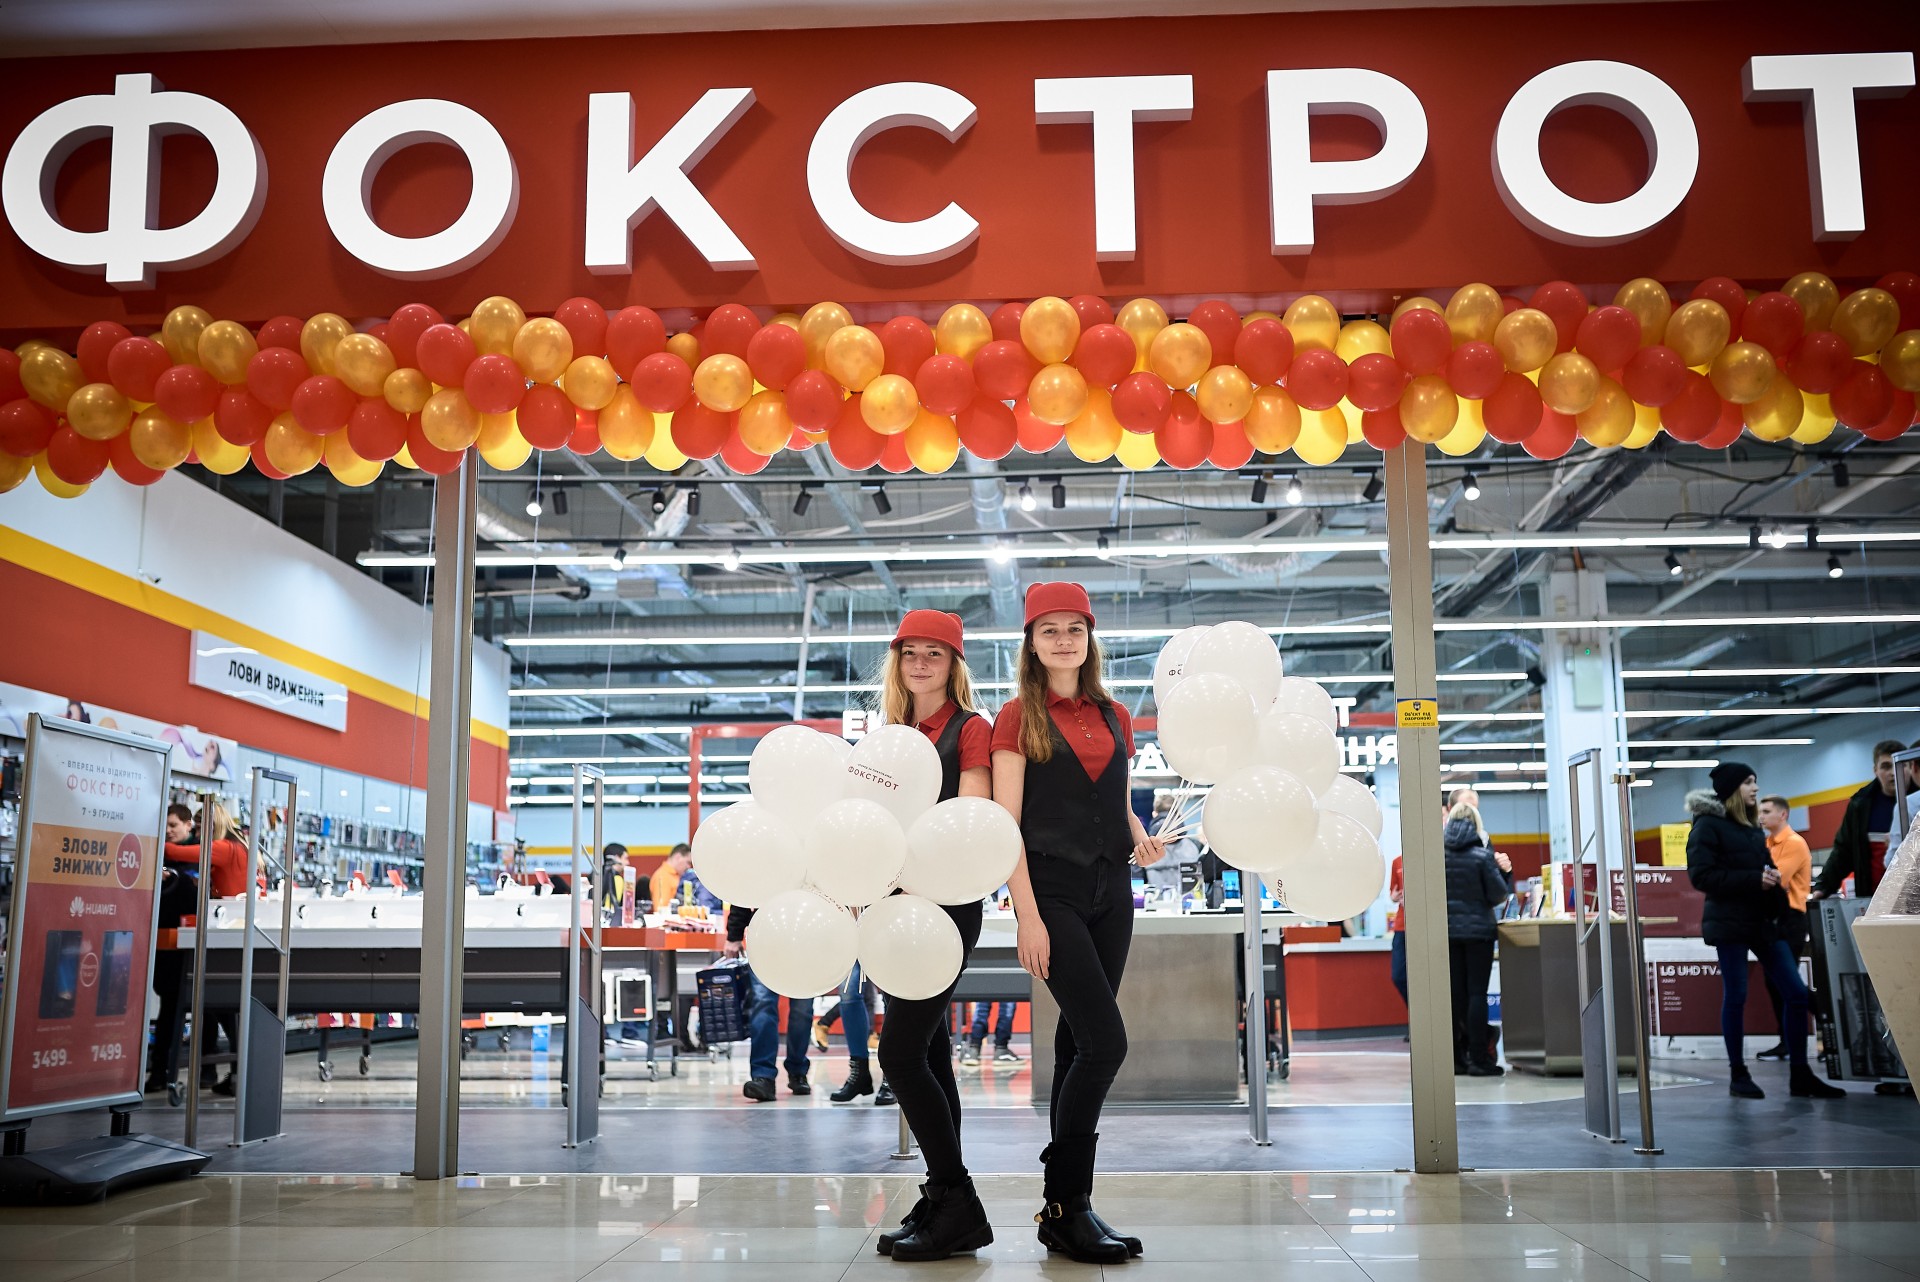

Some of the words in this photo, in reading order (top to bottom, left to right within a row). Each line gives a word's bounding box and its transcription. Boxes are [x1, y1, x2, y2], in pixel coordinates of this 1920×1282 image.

[2, 51, 1916, 287] ФОКСТРОТ
[228, 660, 261, 686] ЛОВИ
[267, 674, 324, 707] ВРАЖЕННЯ
[67, 760, 94, 773] ВПЕРЕД
[96, 766, 106, 774] НА
[107, 770, 142, 780] ВІДКРИТТЯ
[847, 766, 900, 791] ФОКСТРОТ
[66, 773, 141, 801] ФОКСТРОТ
[81, 807, 87, 816] 7
[92, 809, 97, 817] 9
[98, 809, 124, 820] ГРУДНЯ
[62, 837, 108, 856] ЗЛОВИ
[53, 857, 112, 876] ЗНИЖКУ
[1652, 873, 1666, 883] TV
[85, 903, 117, 916] HUAWEI
[1660, 965, 1676, 976] LG
[1678, 965, 1700, 976] UHD
[32, 1049, 68, 1069] 3499
[91, 1043, 122, 1062] 7499
